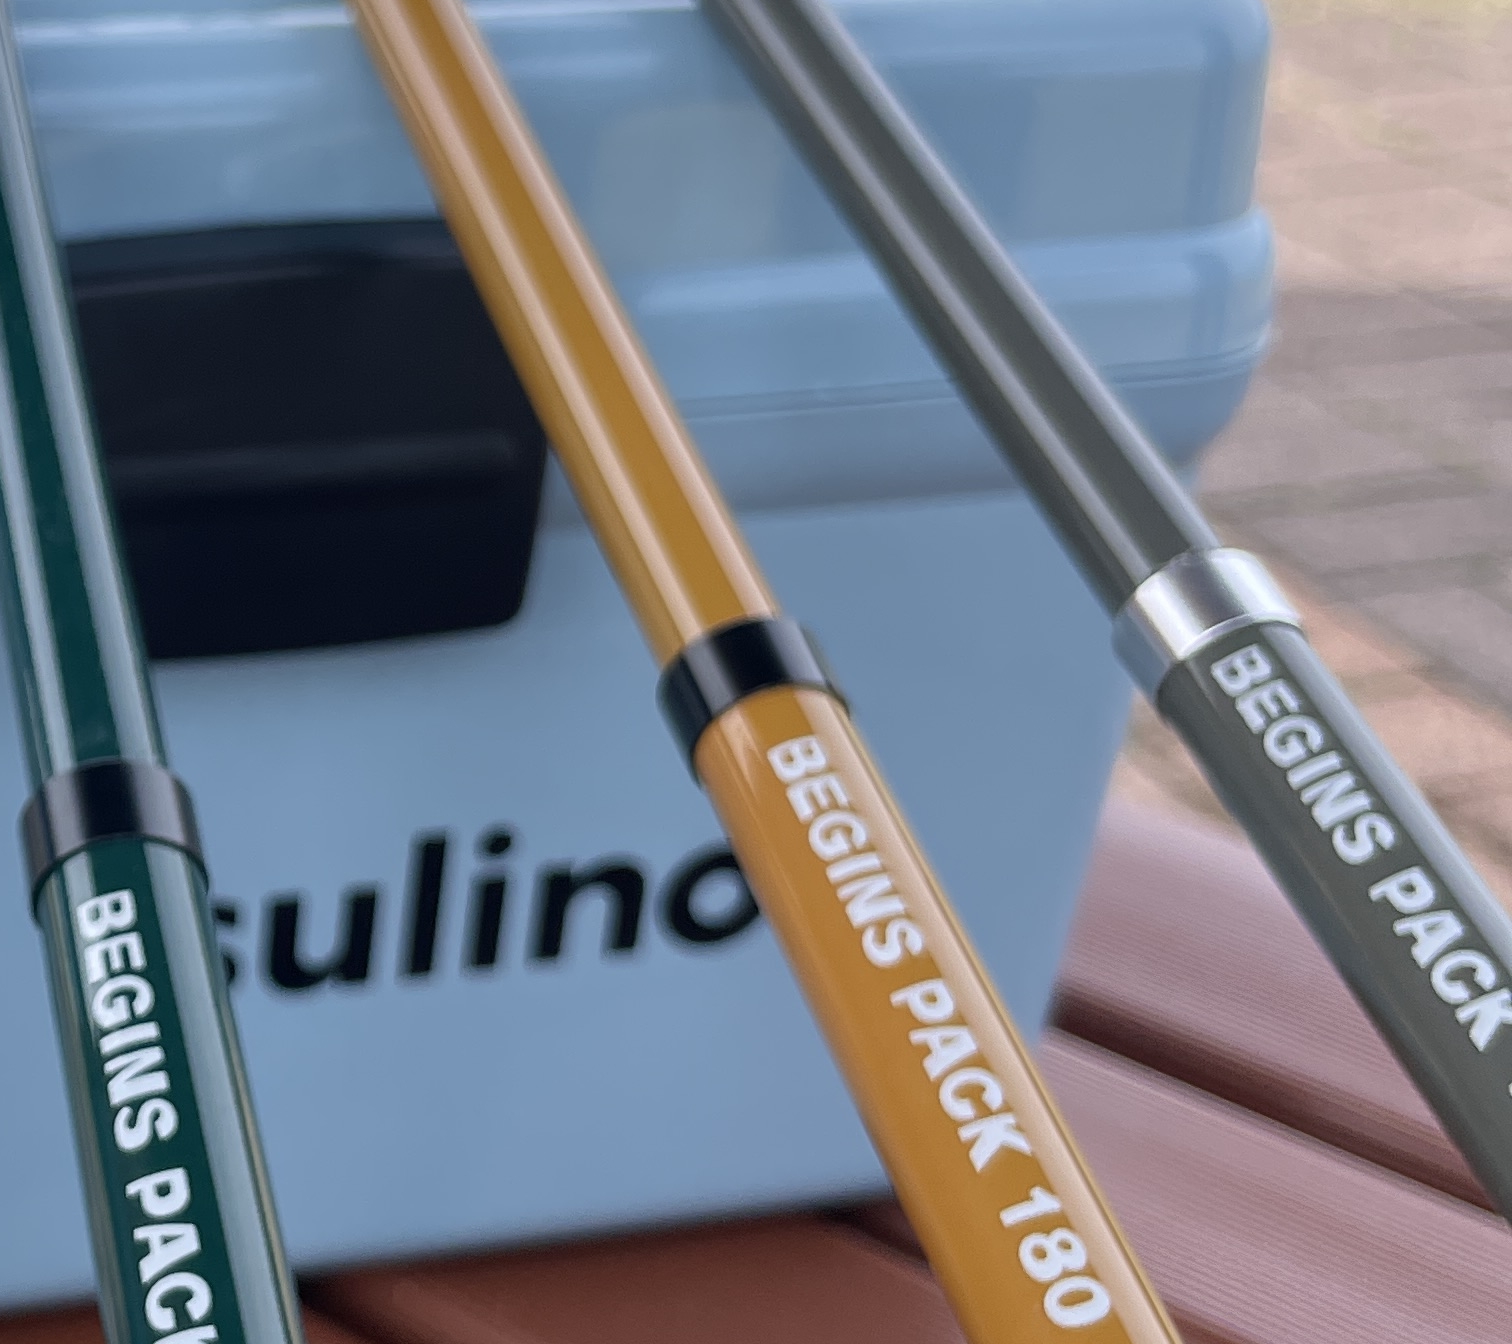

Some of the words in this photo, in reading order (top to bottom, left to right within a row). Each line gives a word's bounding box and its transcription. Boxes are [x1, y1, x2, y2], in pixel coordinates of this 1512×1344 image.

[75, 889, 179, 1153] BEGINS
[767, 735, 923, 969] BEGINS
[890, 979, 1031, 1172] PACK
[999, 1186, 1110, 1328] 180
[1211, 643, 1395, 865] BEGINS
[1369, 866, 1512, 1051] PACK
